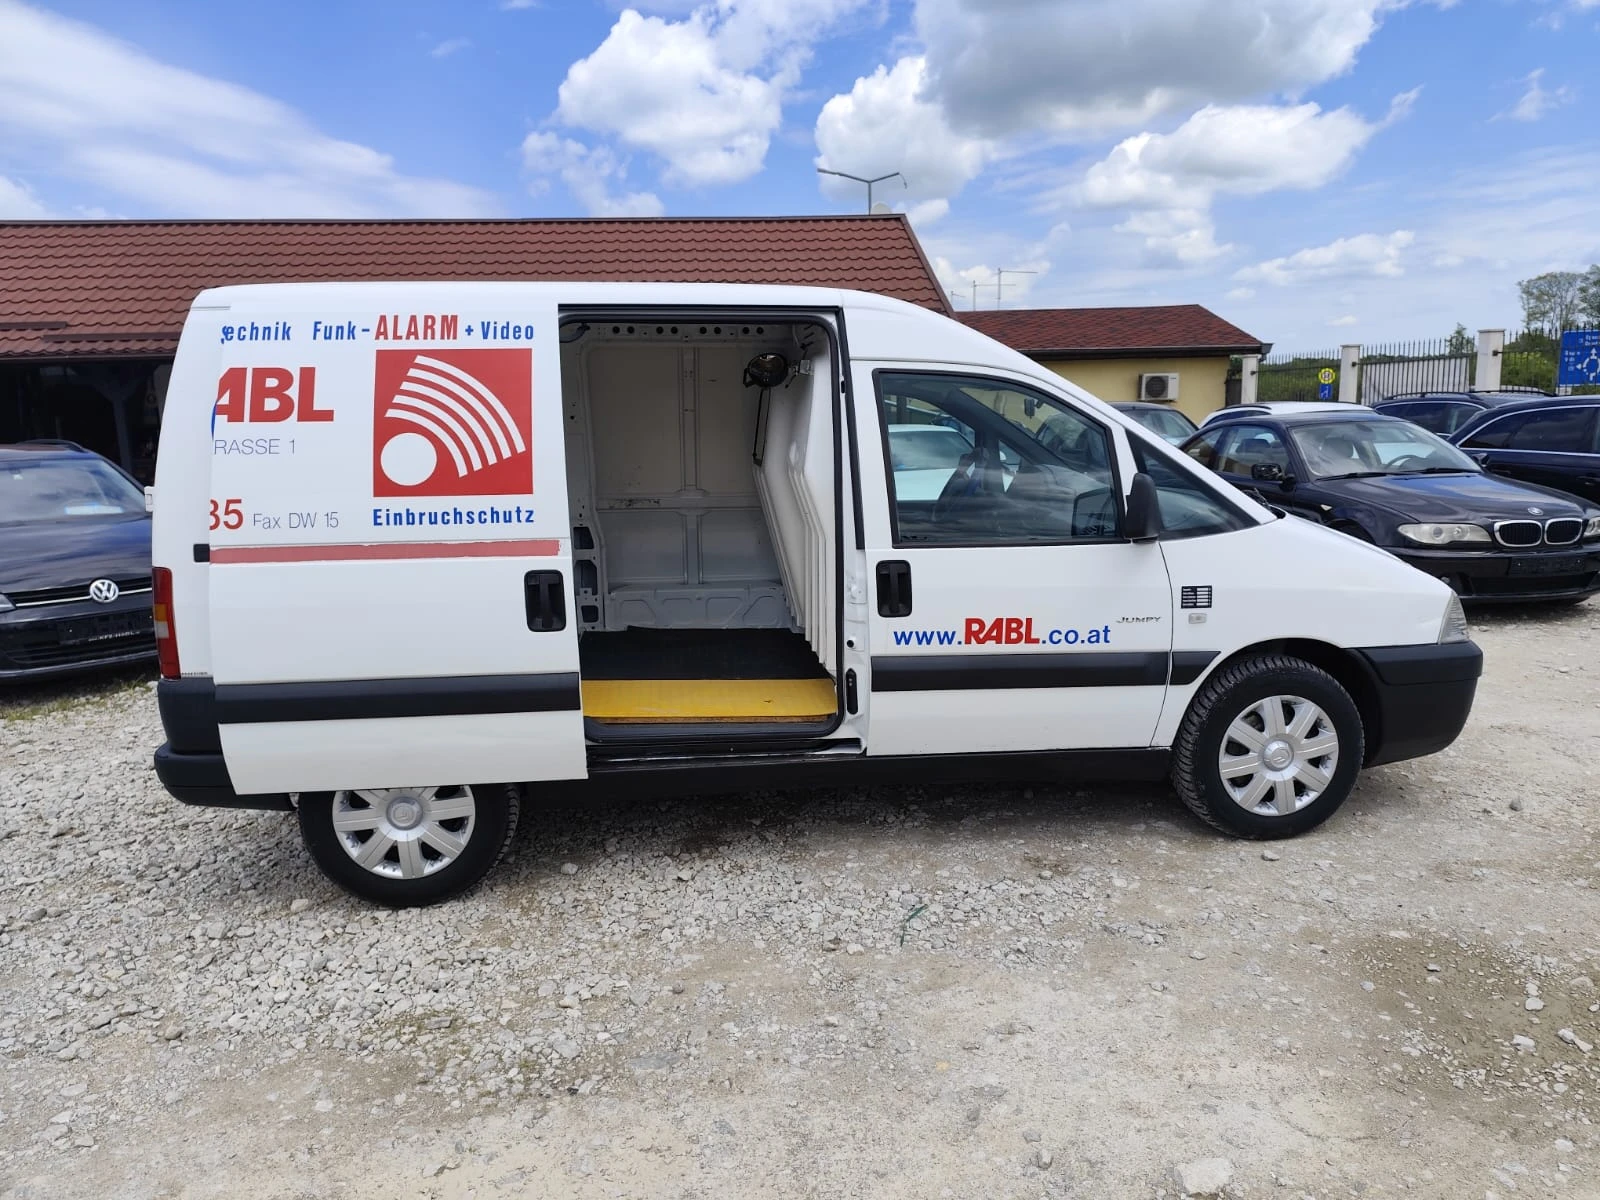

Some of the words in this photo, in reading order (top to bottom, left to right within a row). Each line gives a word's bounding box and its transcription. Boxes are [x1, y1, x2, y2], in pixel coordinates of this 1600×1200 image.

[481, 321, 534, 340] Video
[213, 438, 281, 455] RASSE
[289, 439, 296, 455] 1
[253, 513, 281, 529] Fax
[288, 511, 317, 529] DW
[323, 511, 339, 529] 15
[373, 506, 535, 526] Einbruchschutz
[1115, 616, 1161, 624] JUMPY
[893, 617, 1111, 646] www.RABL.co.at
